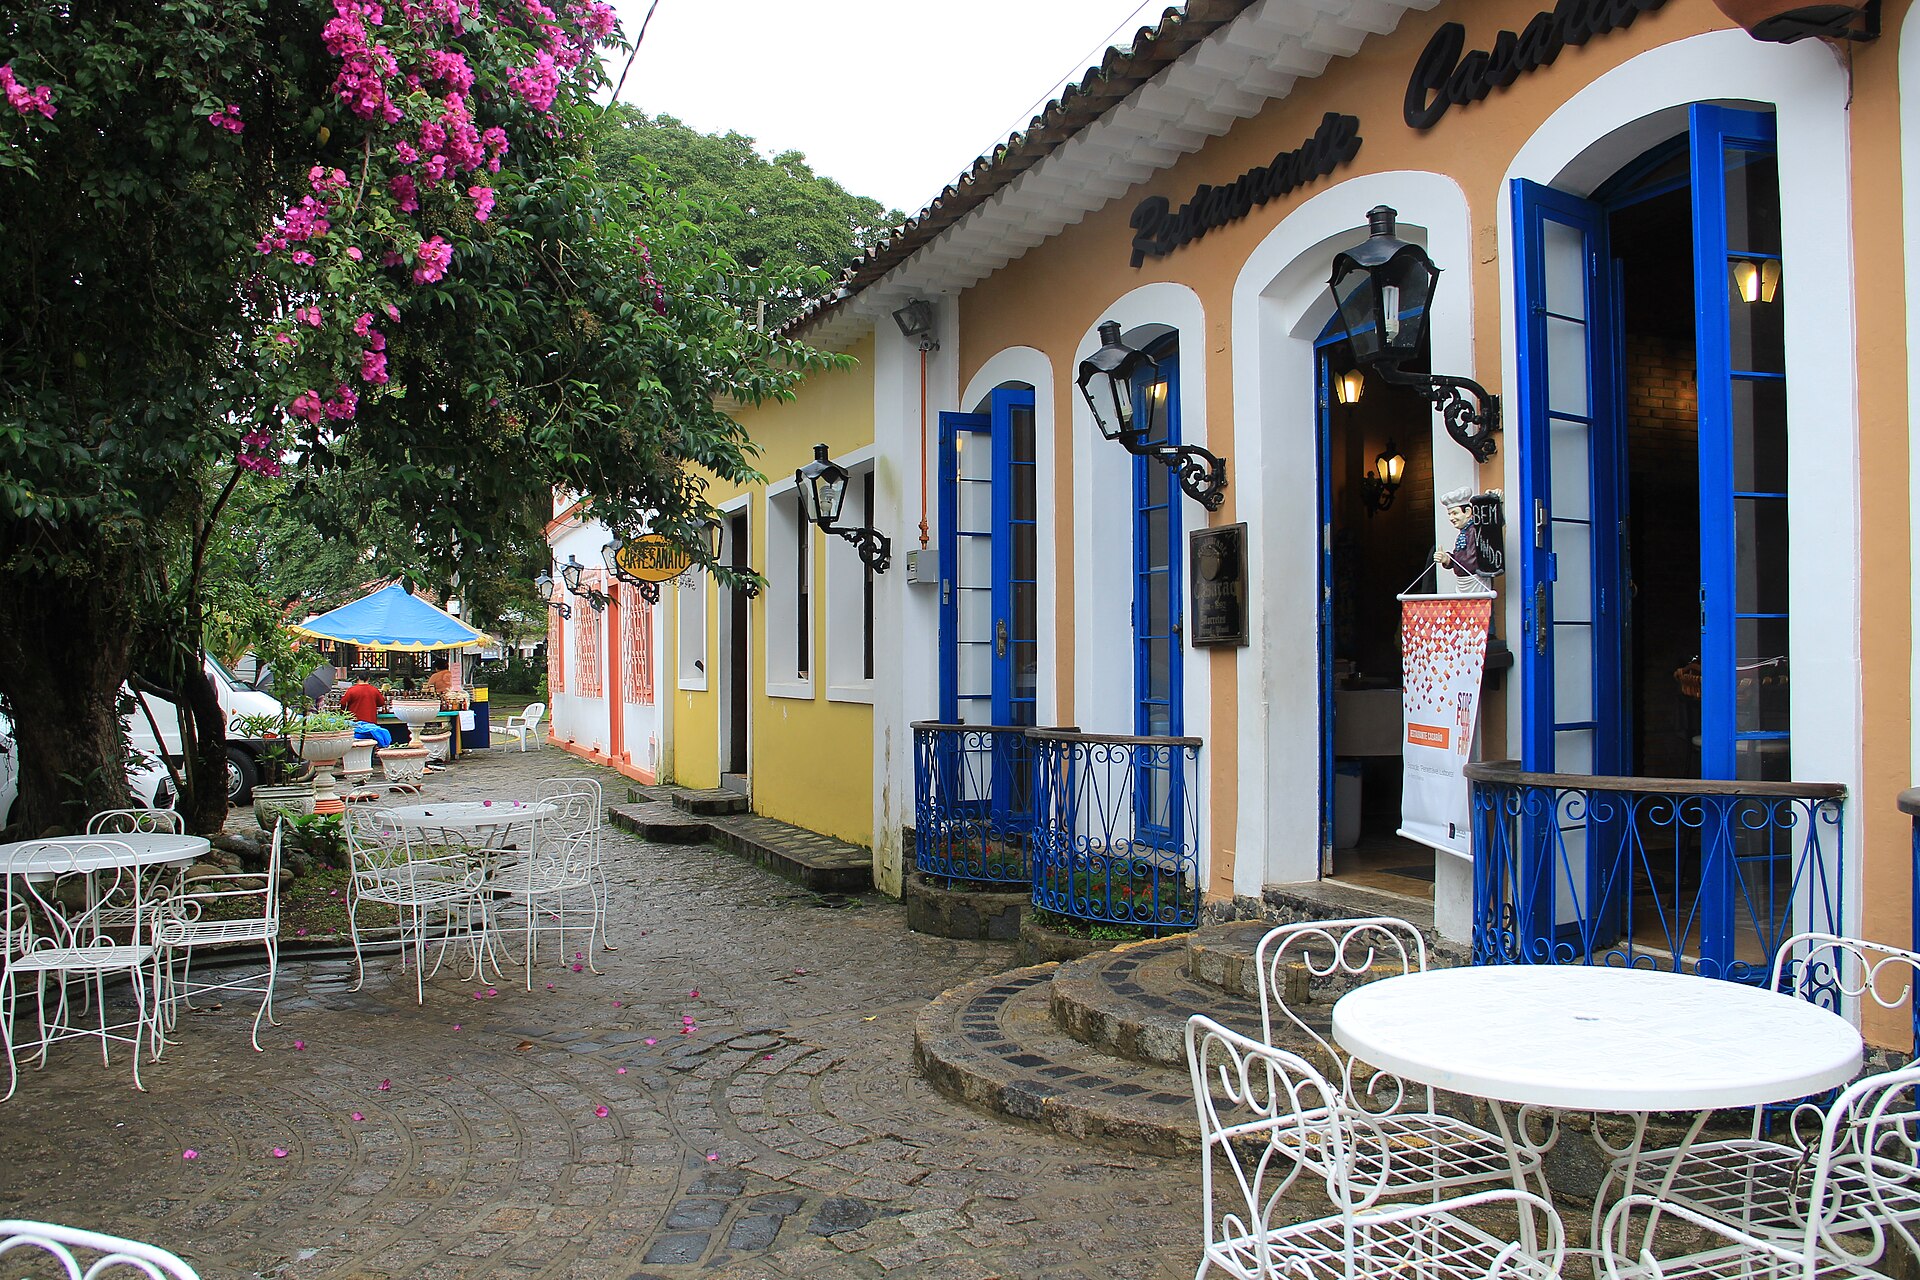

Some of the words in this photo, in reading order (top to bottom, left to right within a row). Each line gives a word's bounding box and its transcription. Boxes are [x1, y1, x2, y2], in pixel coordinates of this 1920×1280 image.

[1130, 112, 1363, 268] Restaurante
[1403, 0, 1676, 130] Casar
[1473, 503, 1498, 526] BEM
[1474, 526, 1502, 568] VINDO
